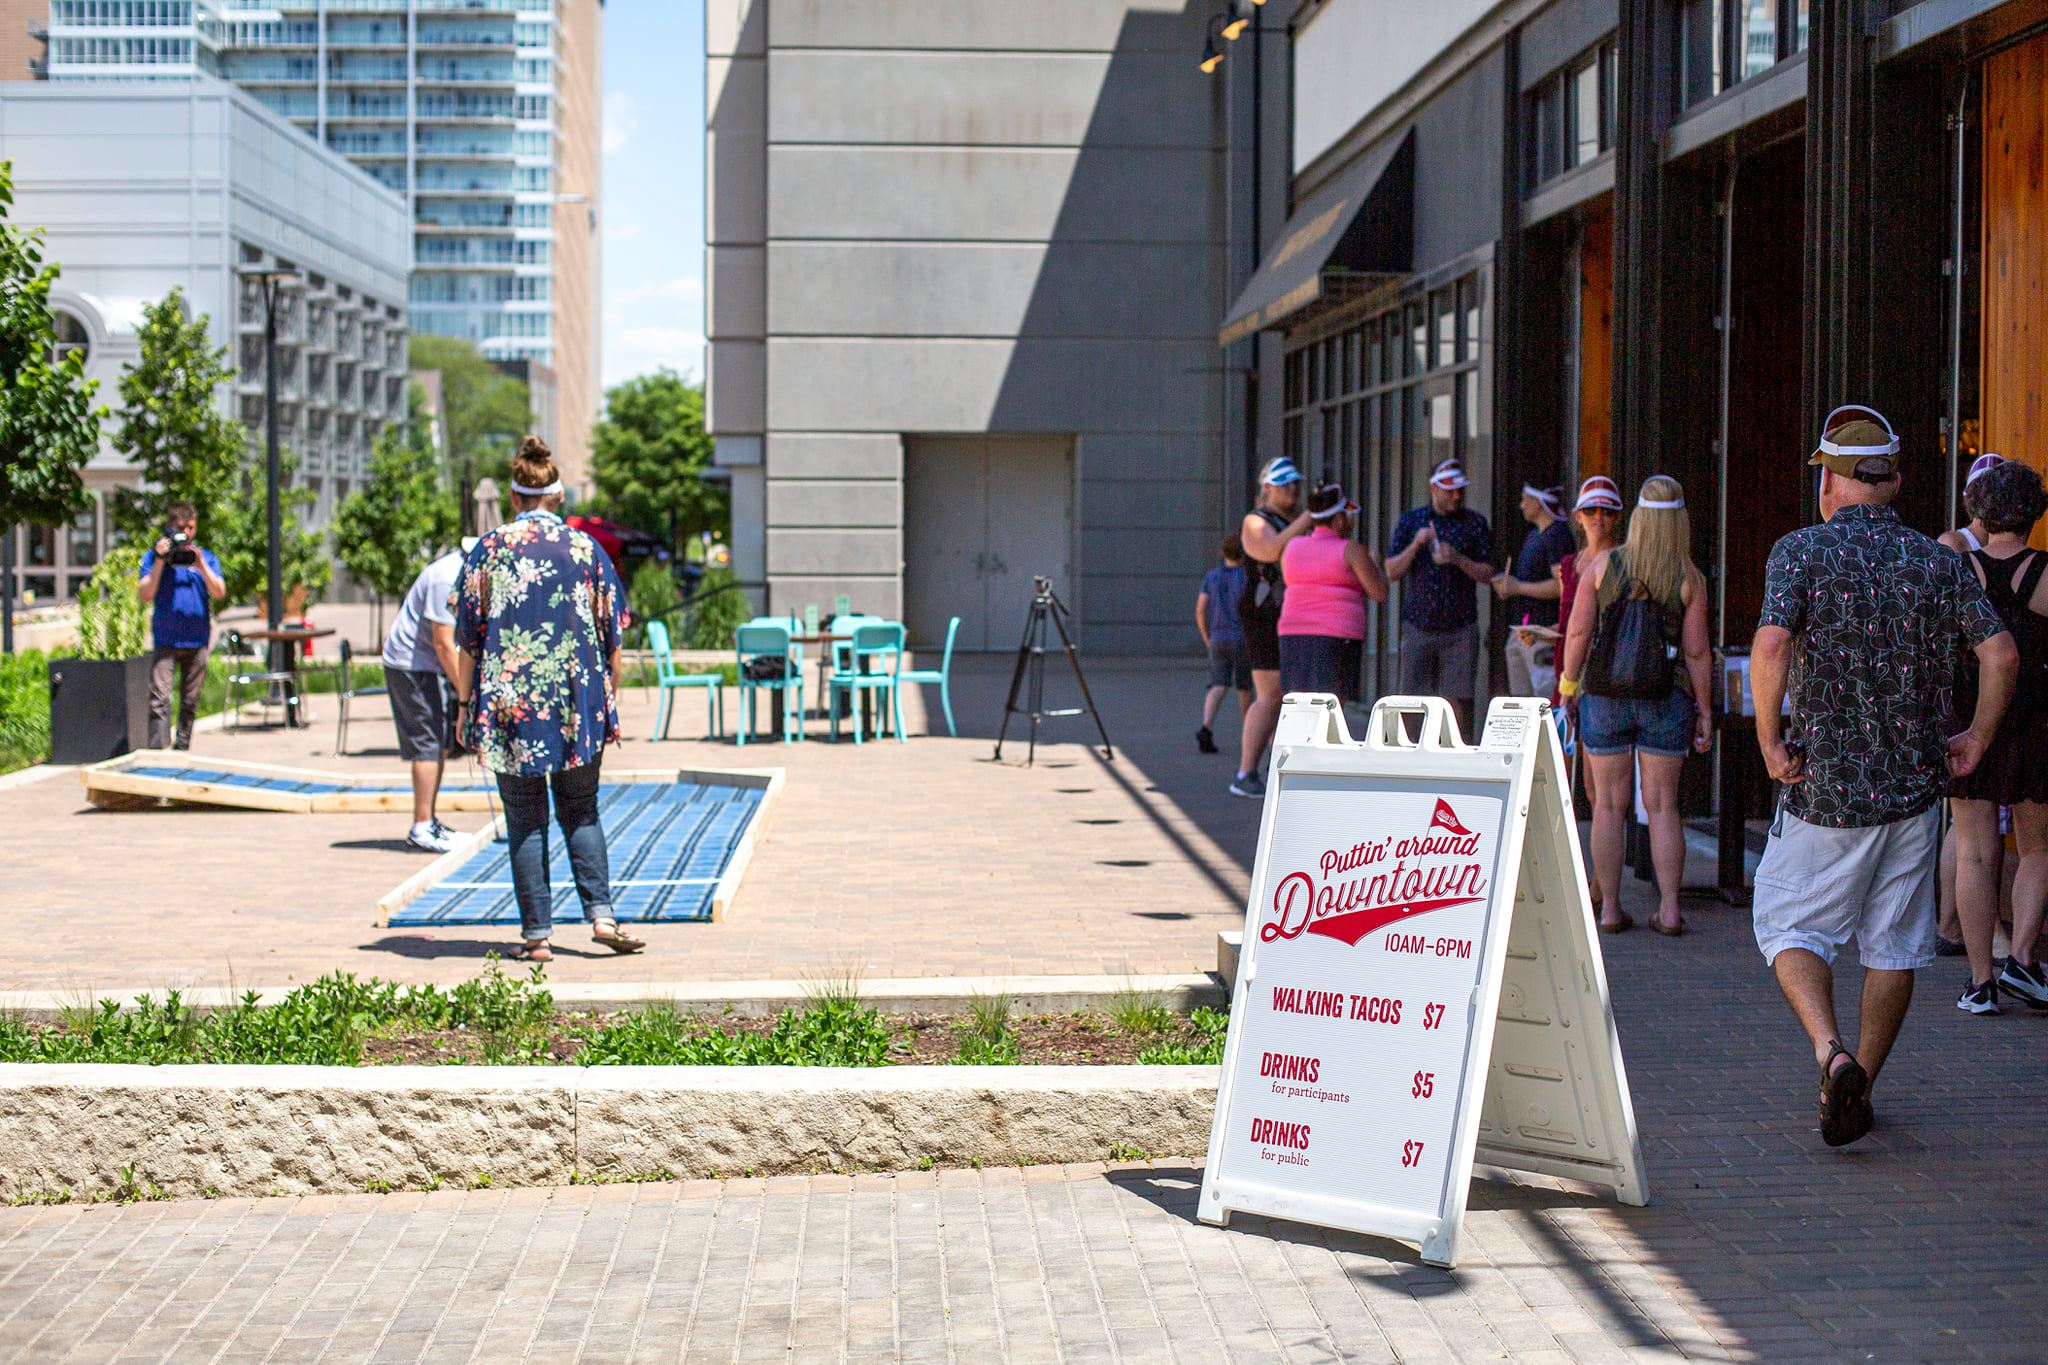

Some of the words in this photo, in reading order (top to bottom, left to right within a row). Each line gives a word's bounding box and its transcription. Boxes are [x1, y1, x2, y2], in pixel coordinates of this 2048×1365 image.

[1394, 832, 1481, 858] around
[1260, 861, 1487, 943] Downtown
[1273, 986, 1344, 1019] WALKING
[1349, 994, 1403, 1025] TACOS
[1423, 1001, 1446, 1031] $7
[1260, 1052, 1321, 1084] DRINKS
[1411, 1070, 1435, 1099] $5
[1271, 1081, 1287, 1093] for
[1288, 1085, 1350, 1103] participants
[1250, 1117, 1311, 1150] DRINKS
[1401, 1138, 1425, 1168] $7
[1260, 1148, 1276, 1160] for
[1277, 1152, 1310, 1166] public
